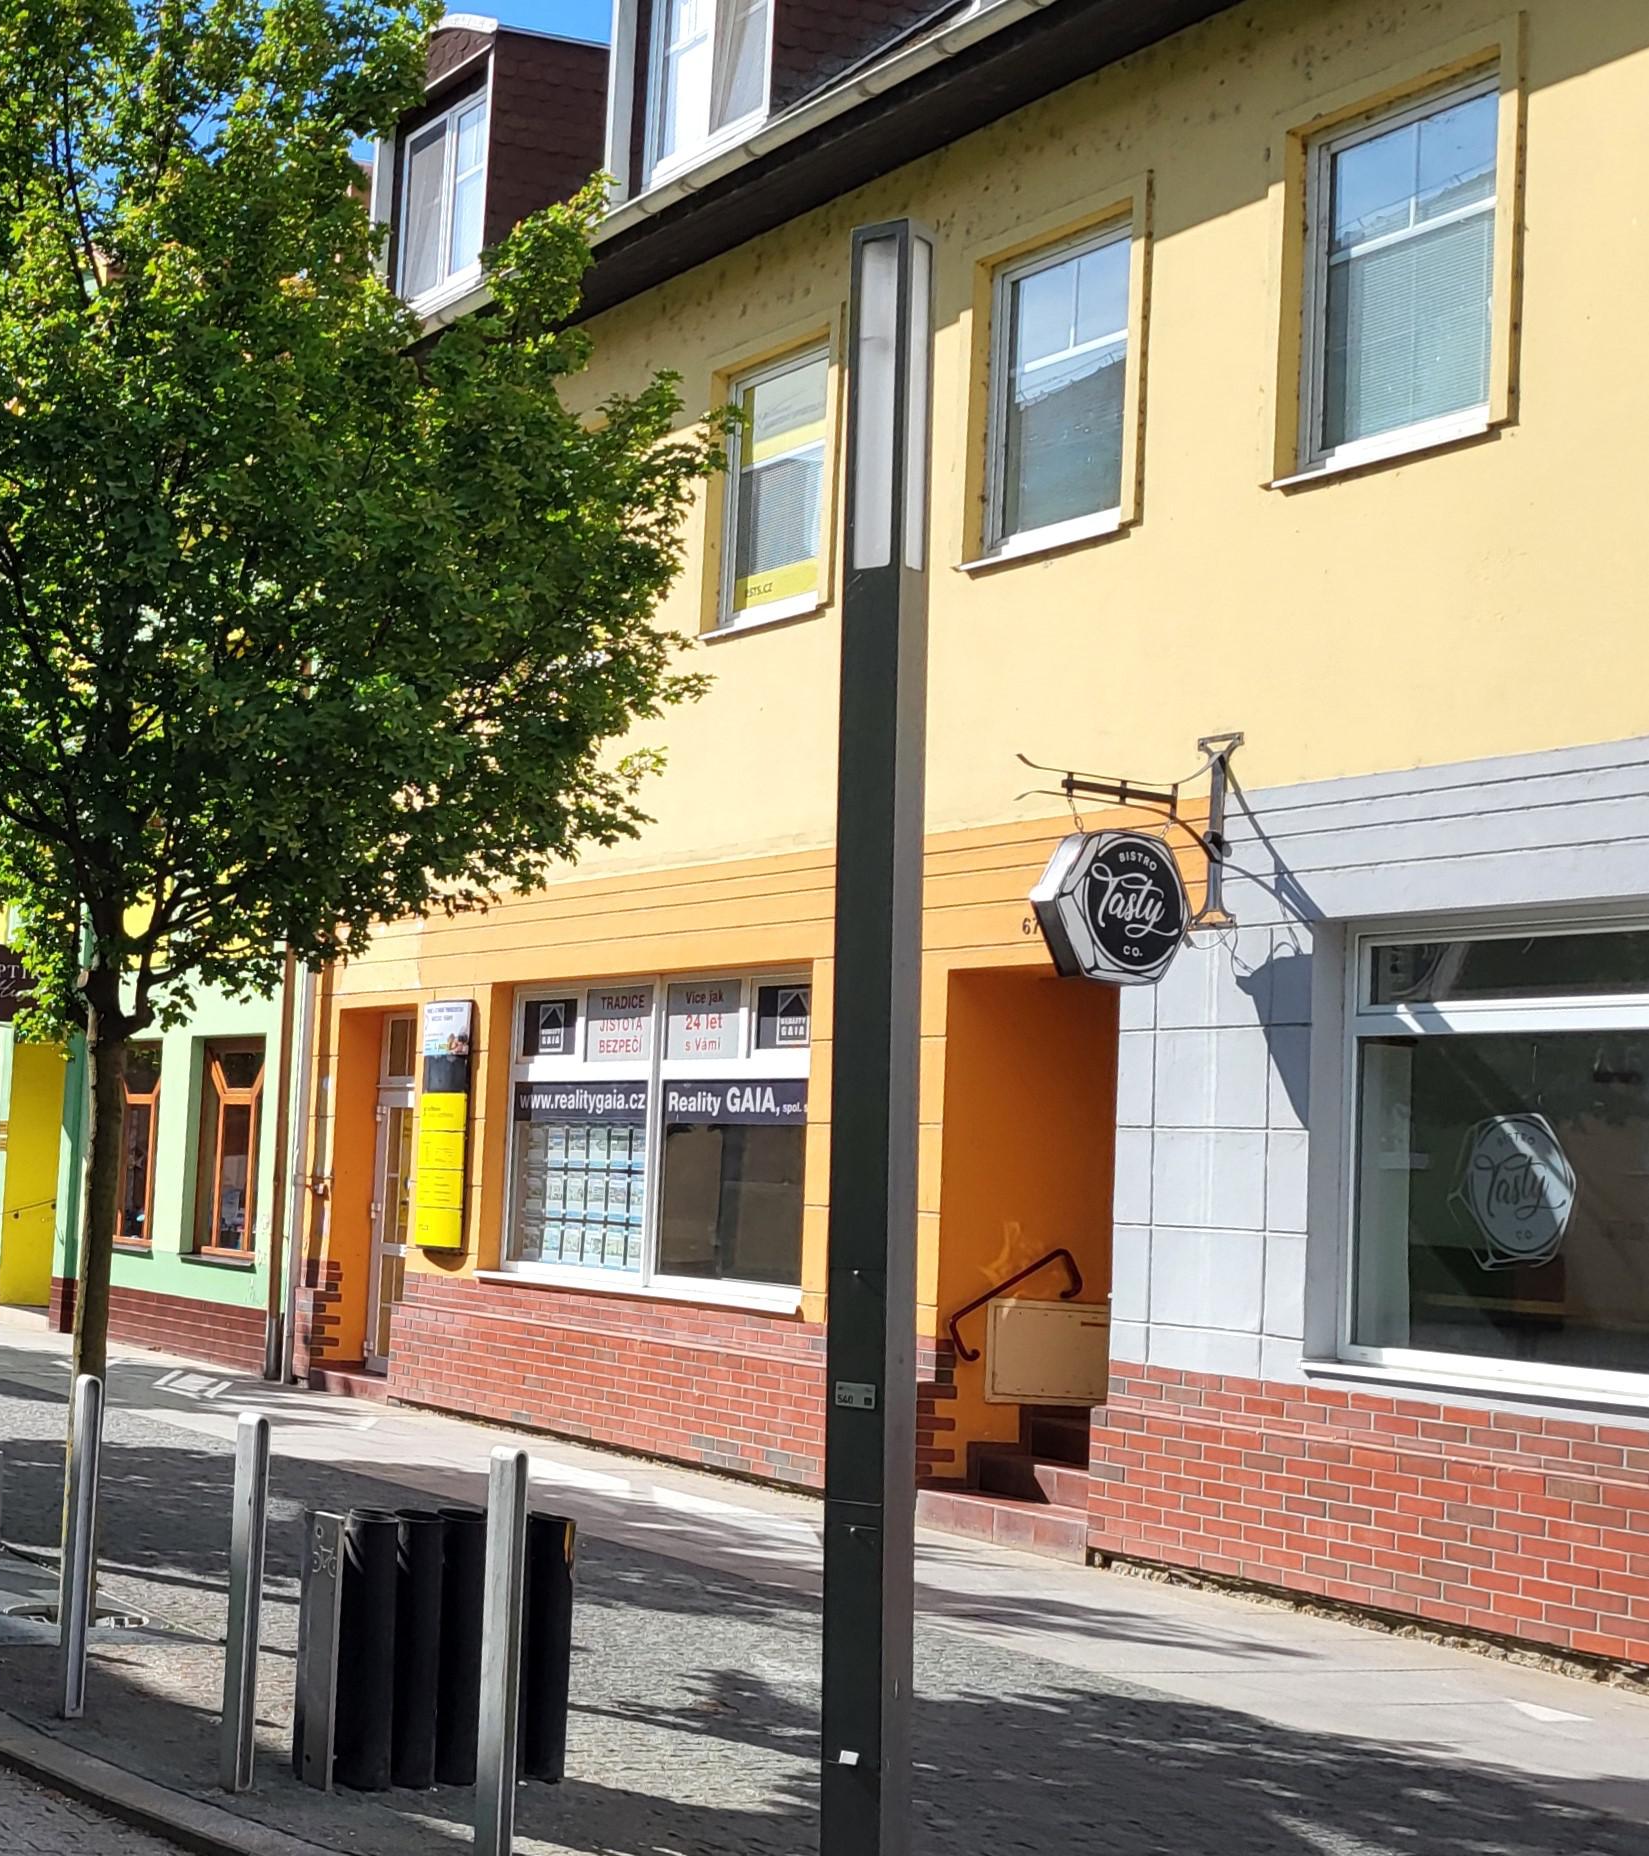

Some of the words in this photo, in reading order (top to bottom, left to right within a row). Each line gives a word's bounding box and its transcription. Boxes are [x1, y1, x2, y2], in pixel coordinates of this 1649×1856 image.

[1118, 851, 1158, 871] BISTRO
[1091, 862, 1179, 938] Tasty
[1123, 945, 1143, 957] CO.
[601, 995, 645, 1010] TRADICE
[708, 990, 723, 1006] jak
[599, 1016, 643, 1032] JISTOTA
[685, 1013, 701, 1030] 24
[706, 1013, 722, 1030] let
[781, 1026, 805, 1036] GAIA
[598, 1036, 642, 1053] BEZPEČÍ
[684, 1040, 691, 1052] s
[519, 1089, 646, 1114] www.realitygaia.cz
[668, 1091, 721, 1117] Reality
[726, 1086, 780, 1117] GAIA,
[782, 1102, 802, 1115] spol.
[1474, 1153, 1567, 1220] Tasty
